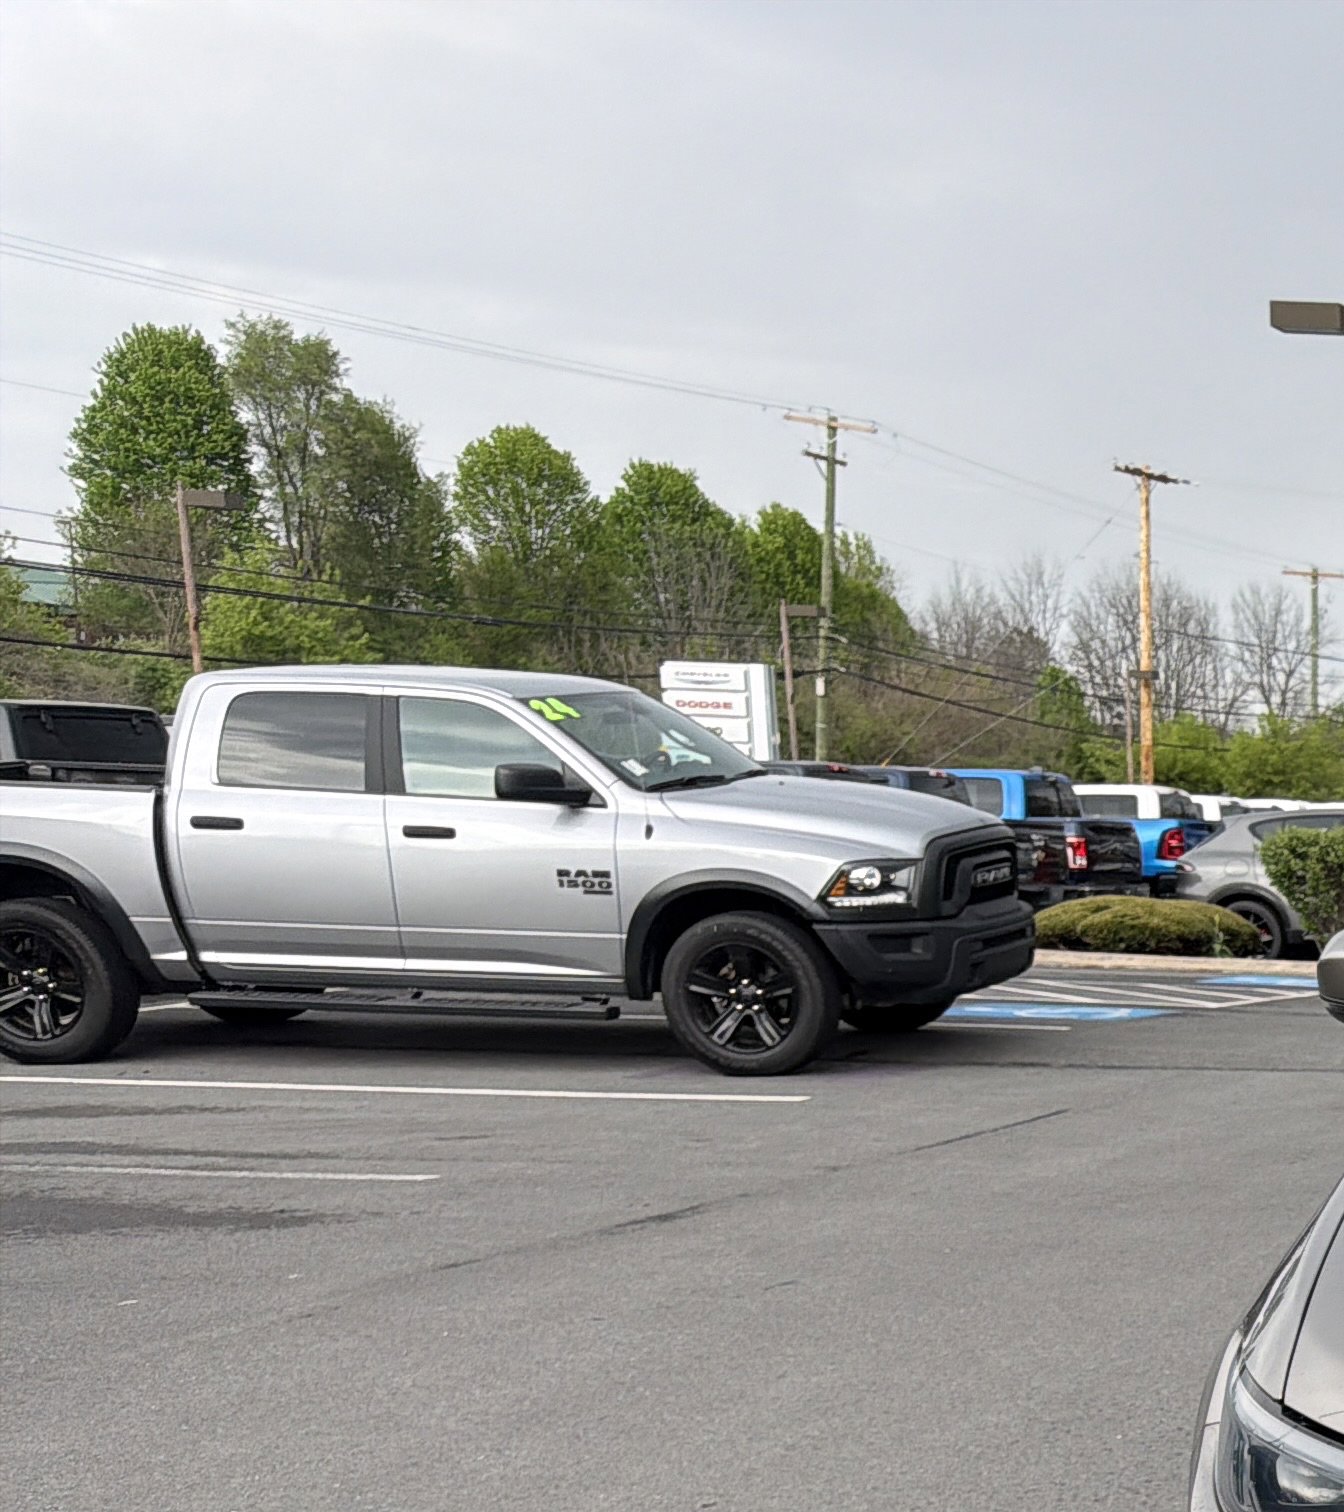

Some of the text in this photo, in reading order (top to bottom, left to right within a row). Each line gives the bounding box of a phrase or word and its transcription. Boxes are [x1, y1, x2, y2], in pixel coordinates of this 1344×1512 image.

[529, 697, 581, 721] 24
[675, 699, 733, 709] DODGE
[556, 869, 611, 878] RAM
[558, 879, 613, 889] 1500
